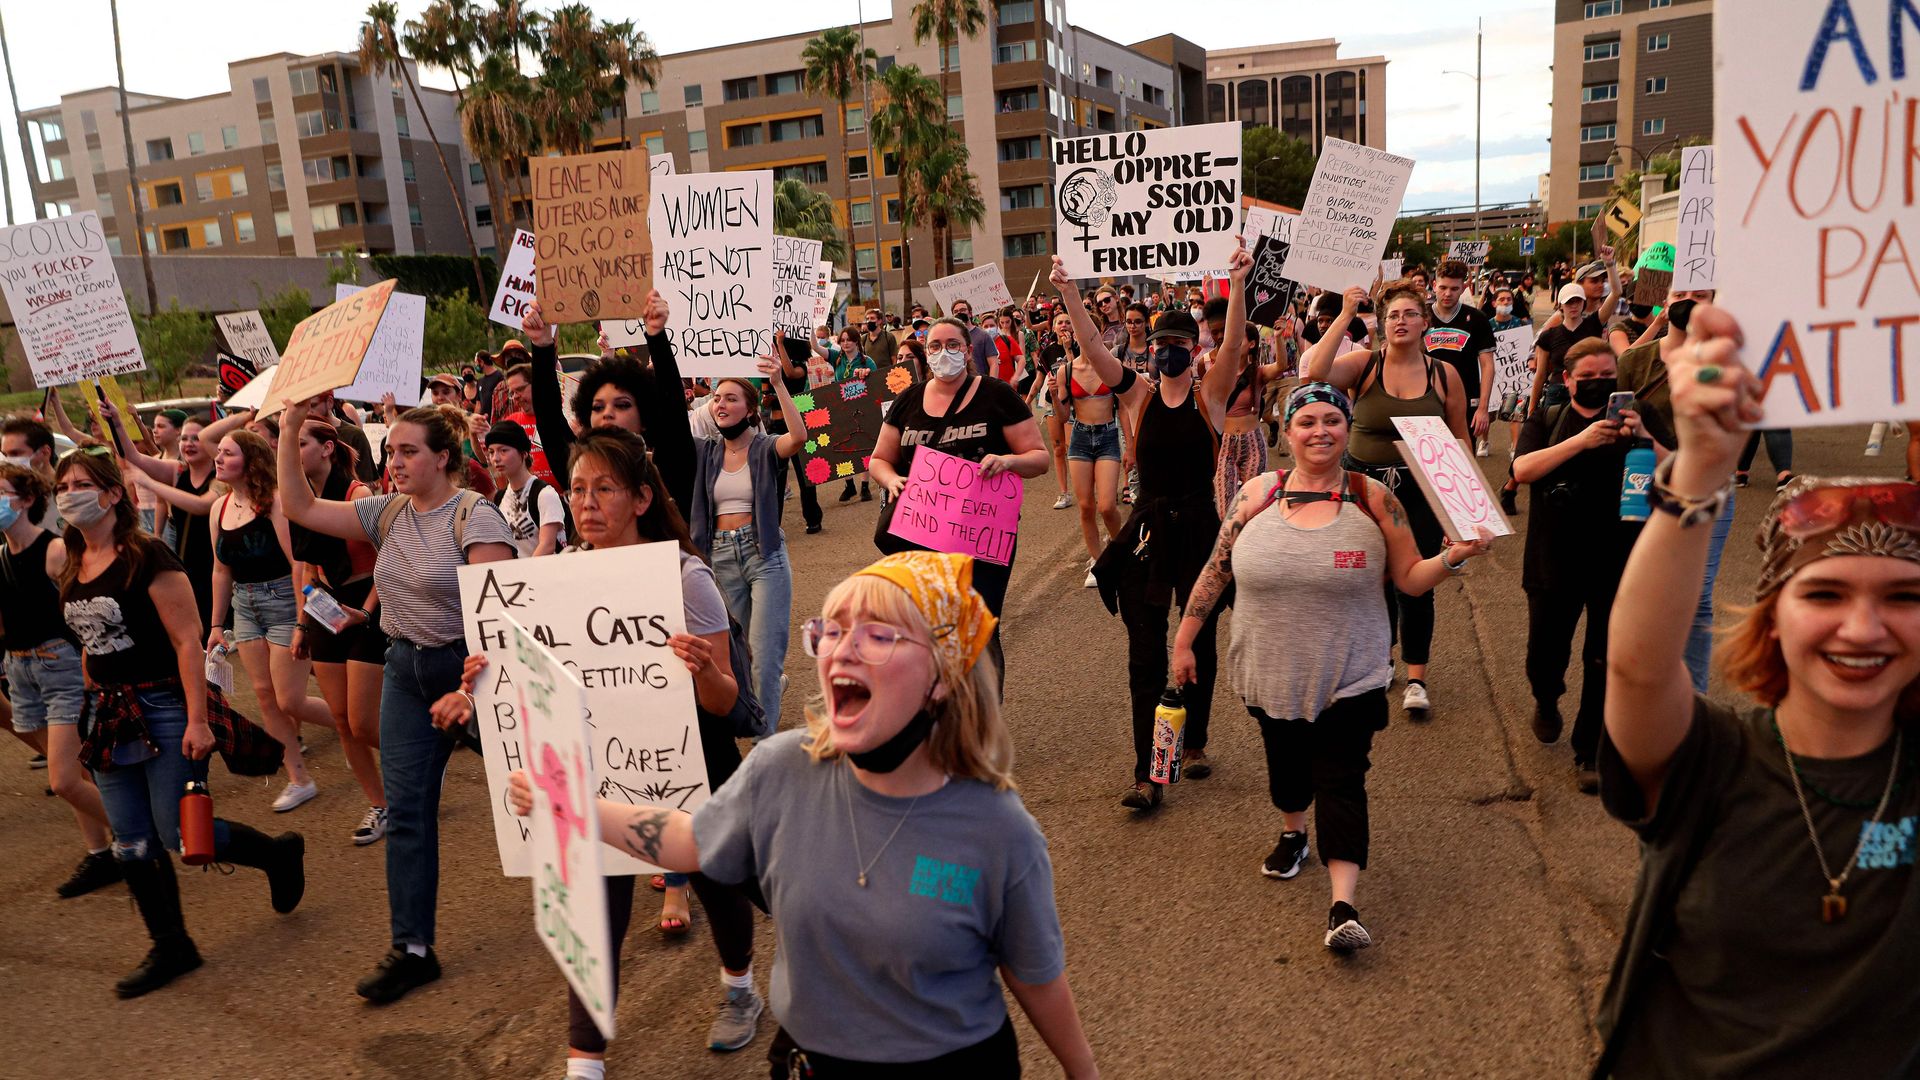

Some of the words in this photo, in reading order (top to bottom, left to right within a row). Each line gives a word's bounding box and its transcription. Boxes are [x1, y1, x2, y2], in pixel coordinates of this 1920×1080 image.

[1056, 132, 1146, 165] HELLO
[1328, 140, 1345, 149] WHAT
[535, 164, 592, 201] LEAVE
[598, 159, 622, 190] MY
[1320, 171, 1366, 188] INJUSTICES
[1368, 182, 1393, 194] HAVE
[1325, 154, 1398, 185] REPRODUCTIVE
[1147, 179, 1236, 209] SSION
[1312, 192, 1323, 204] TO
[1326, 197, 1355, 210] BIPOC
[1358, 204, 1382, 215] AND
[1315, 180, 1339, 194] BEEN
[1342, 188, 1389, 205] HAPPENING
[538, 197, 607, 231] UTERUS
[609, 194, 645, 220] ALONE
[662, 179, 759, 238] WOMEN
[1111, 210, 1152, 237] MY
[1173, 206, 1234, 234] OLD
[1307, 205, 1323, 218] THE
[1326, 207, 1373, 227] DISABLED
[538, 231, 579, 260] OR
[581, 226, 615, 254] GO
[1302, 217, 1328, 232] AND
[1330, 222, 1349, 235] THE
[1349, 227, 1377, 241] POOR
[1092, 241, 1200, 272] FRIEND
[1296, 230, 1374, 258] FOREVER
[1454, 242, 1485, 252] ABORT
[1523, 239, 1531, 250] P
[1, 266, 26, 292] YOU
[32, 255, 94, 278] FUCKED
[659, 247, 706, 283] ARE
[709, 245, 762, 279] NOT
[1291, 248, 1303, 259] IN
[1308, 251, 1328, 264] THIS
[1332, 256, 1373, 271] COUNTRY
[25, 279, 58, 295] WITH
[61, 271, 91, 286] THE
[505, 274, 536, 296] HUM
[540, 263, 591, 299] FUCK
[592, 252, 653, 289] YOURSELF
[773, 279, 816, 297] ISTENCE
[1256, 271, 1289, 292] Choice
[26, 289, 73, 309] WRONG
[678, 284, 753, 326] YOUR
[773, 294, 793, 312] OR
[223, 315, 258, 338] Regulate
[301, 297, 364, 342] FETUS
[790, 311, 810, 329] OUR
[272, 321, 374, 395] DELETUS
[1496, 352, 1519, 366] THE
[844, 384, 859, 393] NOT
[845, 388, 866, 399] AGAIN
[918, 451, 1019, 500] SCOTUS
[908, 483, 955, 511] CAN'T
[961, 499, 998, 518] EVEN
[900, 505, 939, 534] FIND
[948, 521, 976, 543] THE
[975, 526, 1018, 560] CLIT
[478, 619, 572, 651] FEAL
[586, 606, 671, 647] CATS
[606, 725, 689, 773] CARE!
